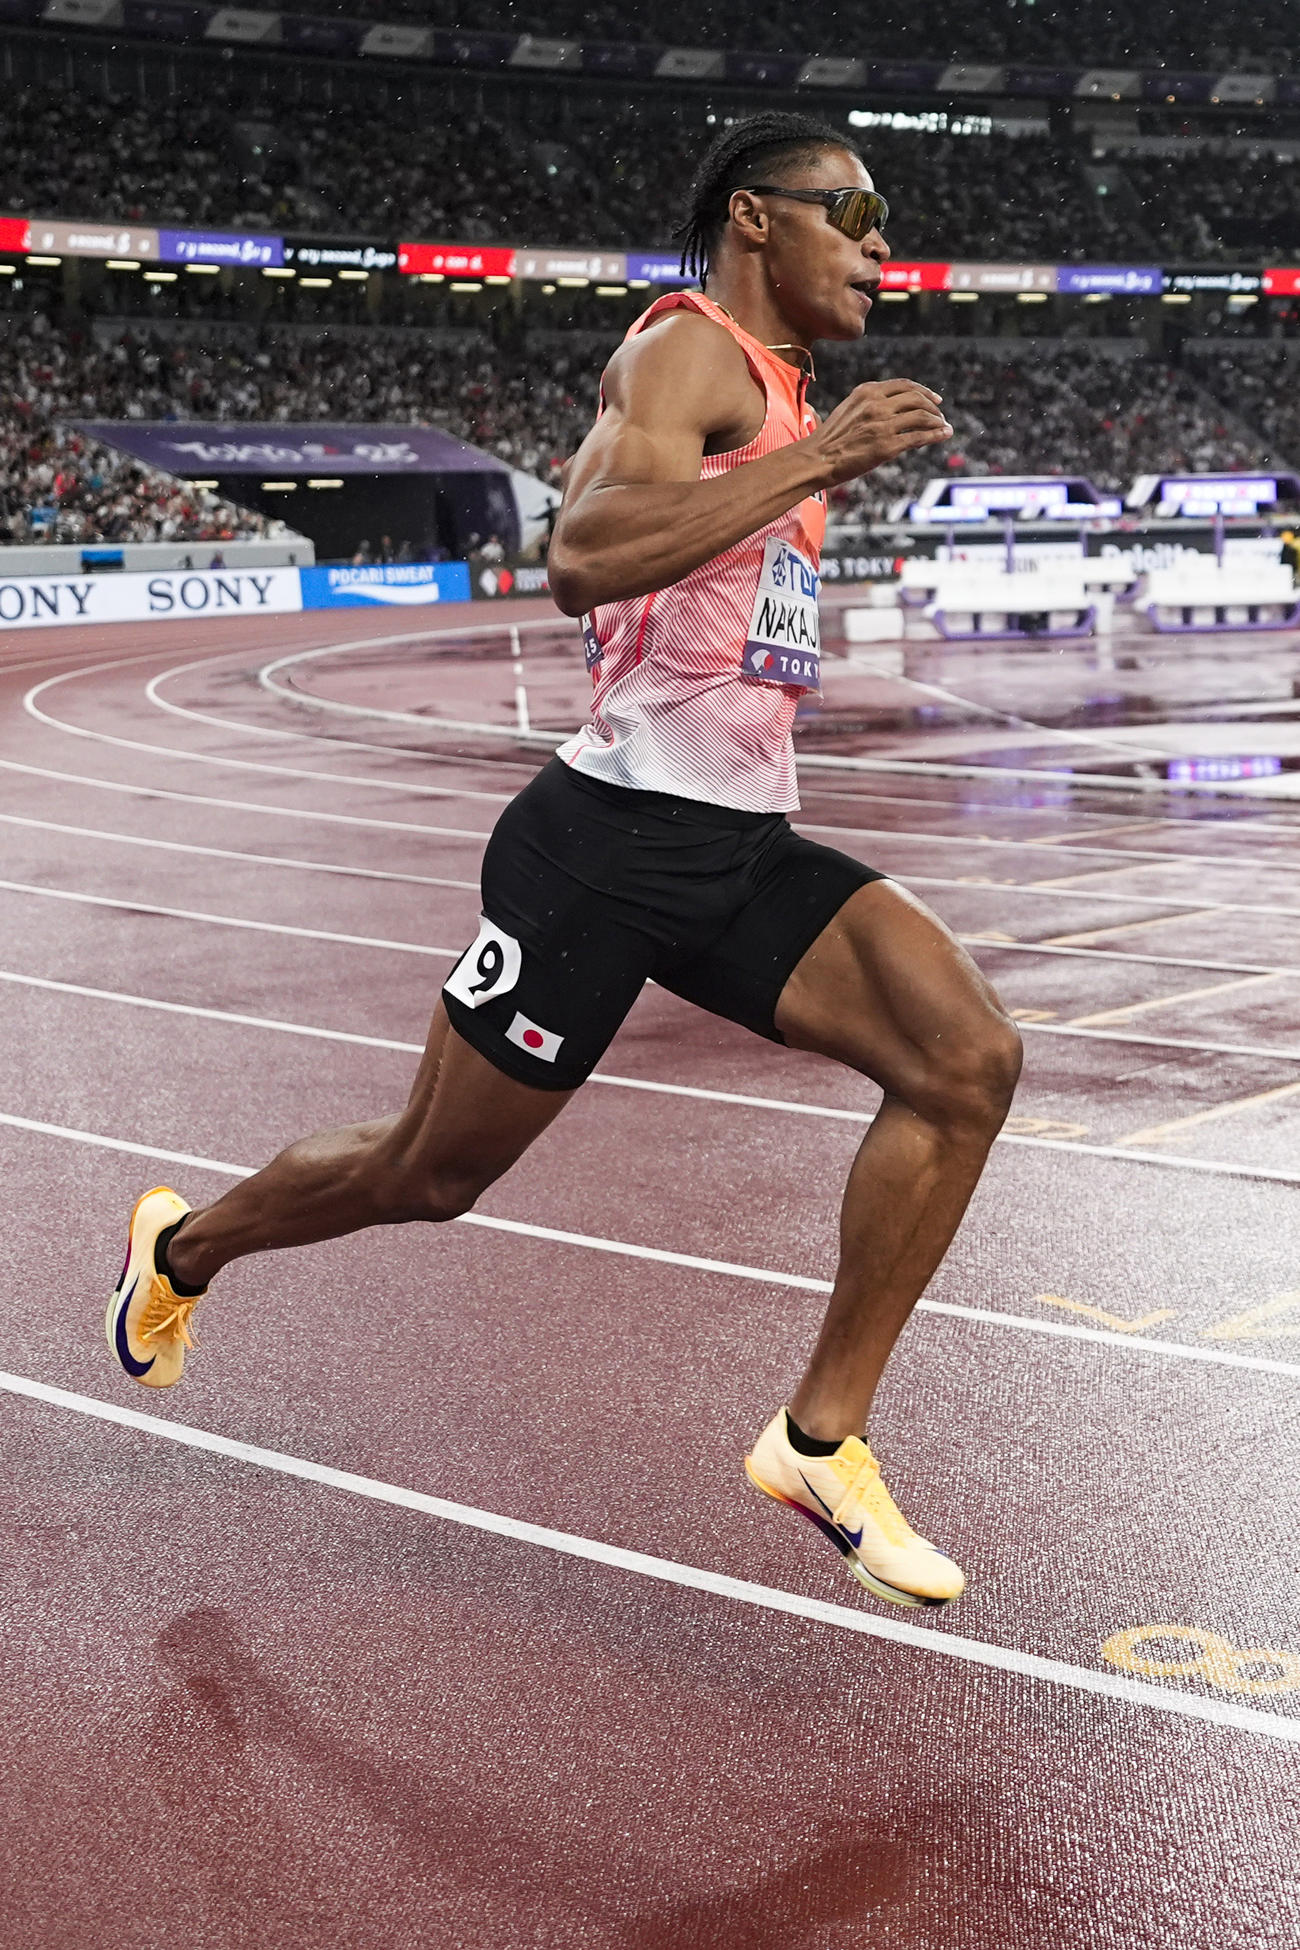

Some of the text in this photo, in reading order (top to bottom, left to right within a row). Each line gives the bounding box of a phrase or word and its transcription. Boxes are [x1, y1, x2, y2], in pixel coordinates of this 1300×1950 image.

[147, 575, 275, 612] SONY
[328, 565, 435, 586] POCARI SWEAT
[468, 940, 504, 996] 9
